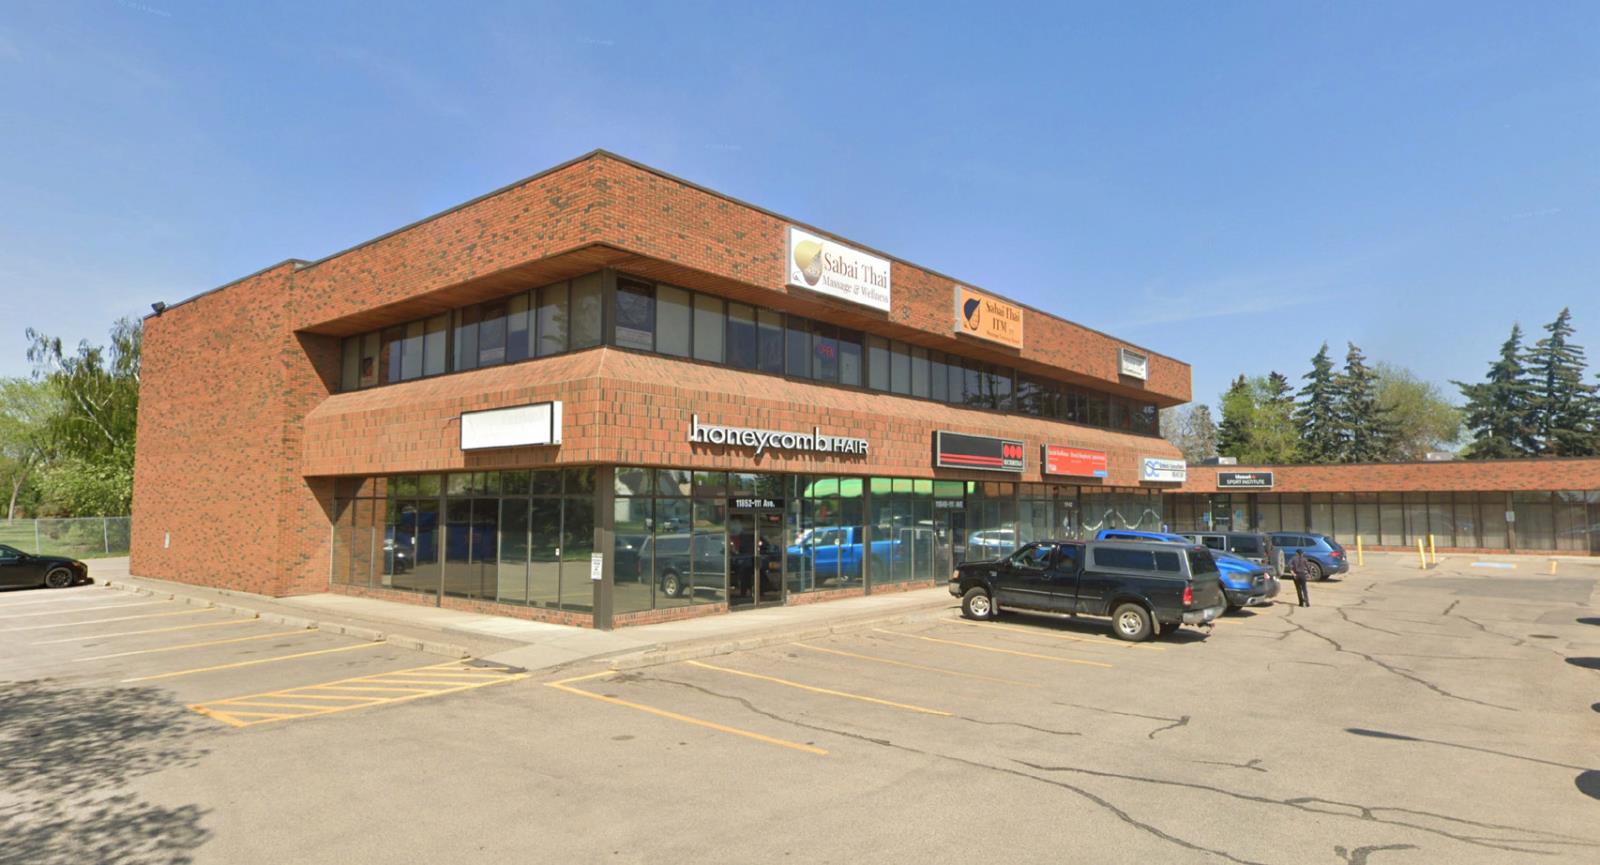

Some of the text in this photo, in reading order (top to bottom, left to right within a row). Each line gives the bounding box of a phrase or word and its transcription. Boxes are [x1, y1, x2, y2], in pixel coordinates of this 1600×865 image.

[824, 252, 887, 289] Sabai Thai
[822, 275, 852, 293] Massage
[861, 286, 889, 304] Wellness
[691, 414, 870, 454] honeycomb HAIR
